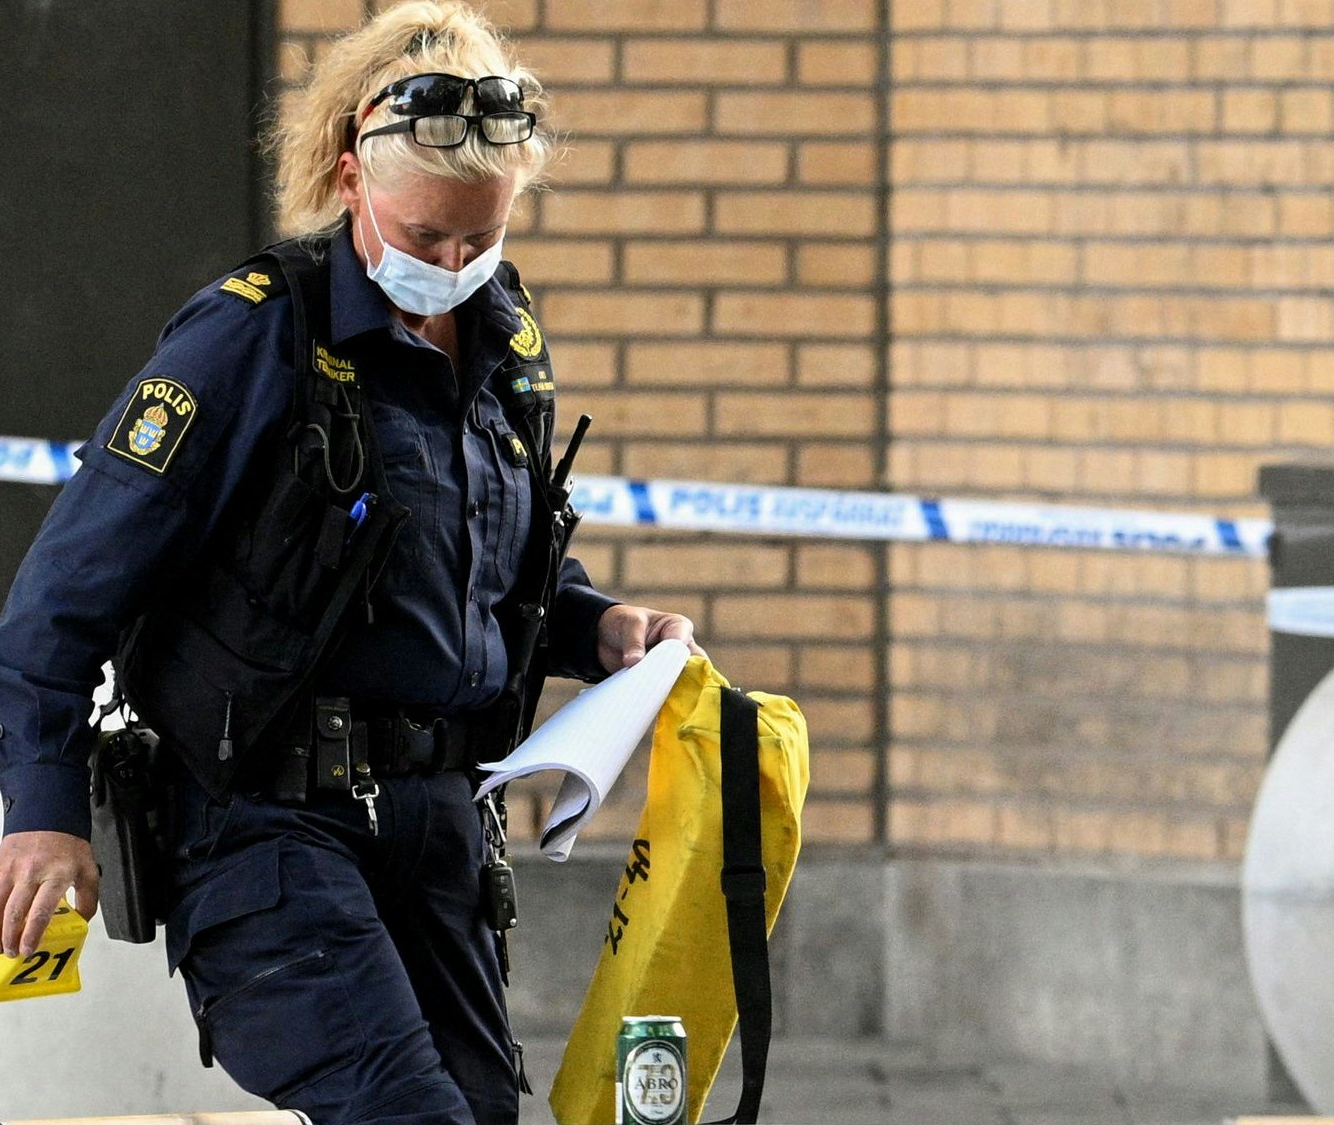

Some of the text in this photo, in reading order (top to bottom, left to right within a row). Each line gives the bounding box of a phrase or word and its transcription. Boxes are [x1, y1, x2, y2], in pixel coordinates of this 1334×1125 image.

[316, 346, 355, 370] KNAL
[316, 359, 355, 382] TEKER
[142, 383, 192, 416] POLIS
[9, 947, 76, 985] 21
